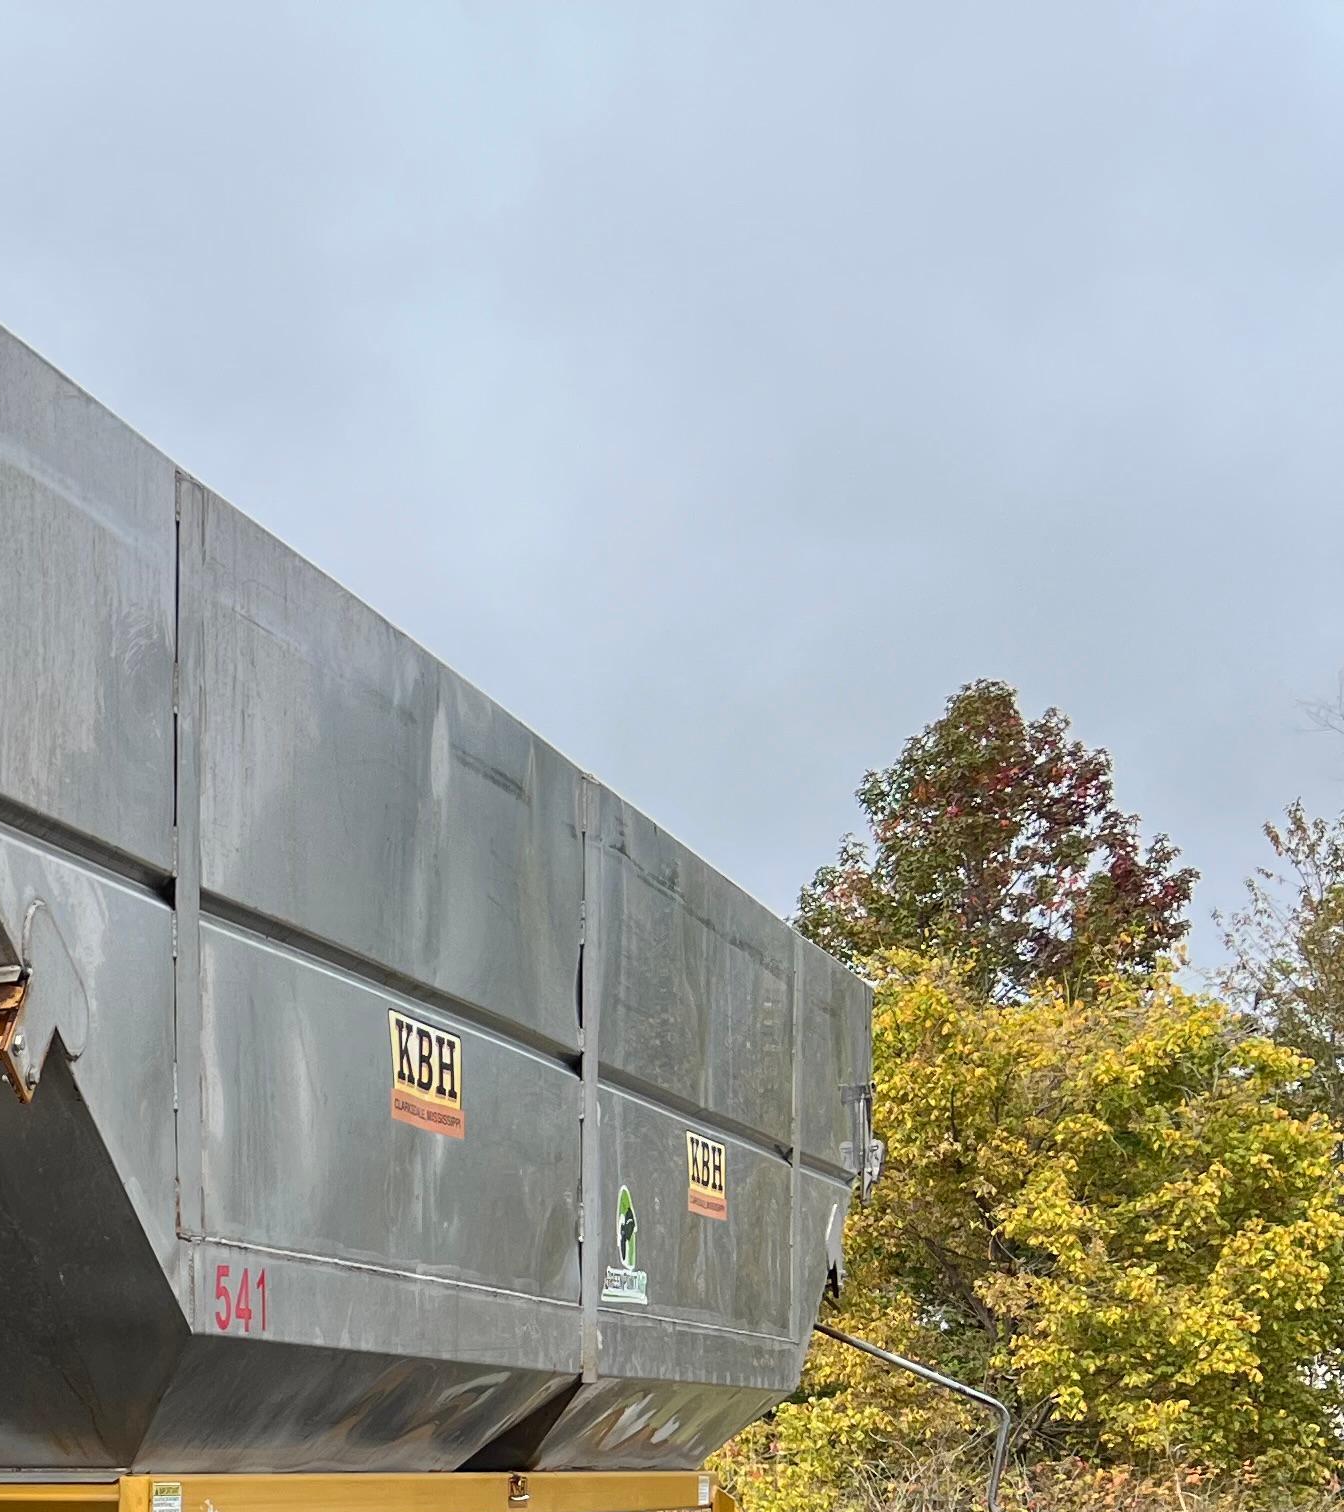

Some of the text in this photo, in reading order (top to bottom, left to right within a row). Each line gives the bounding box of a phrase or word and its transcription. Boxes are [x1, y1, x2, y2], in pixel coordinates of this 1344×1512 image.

[395, 1018, 458, 1102] KBH
[690, 1136, 723, 1192] KBH
[214, 1264, 266, 1333] 541
